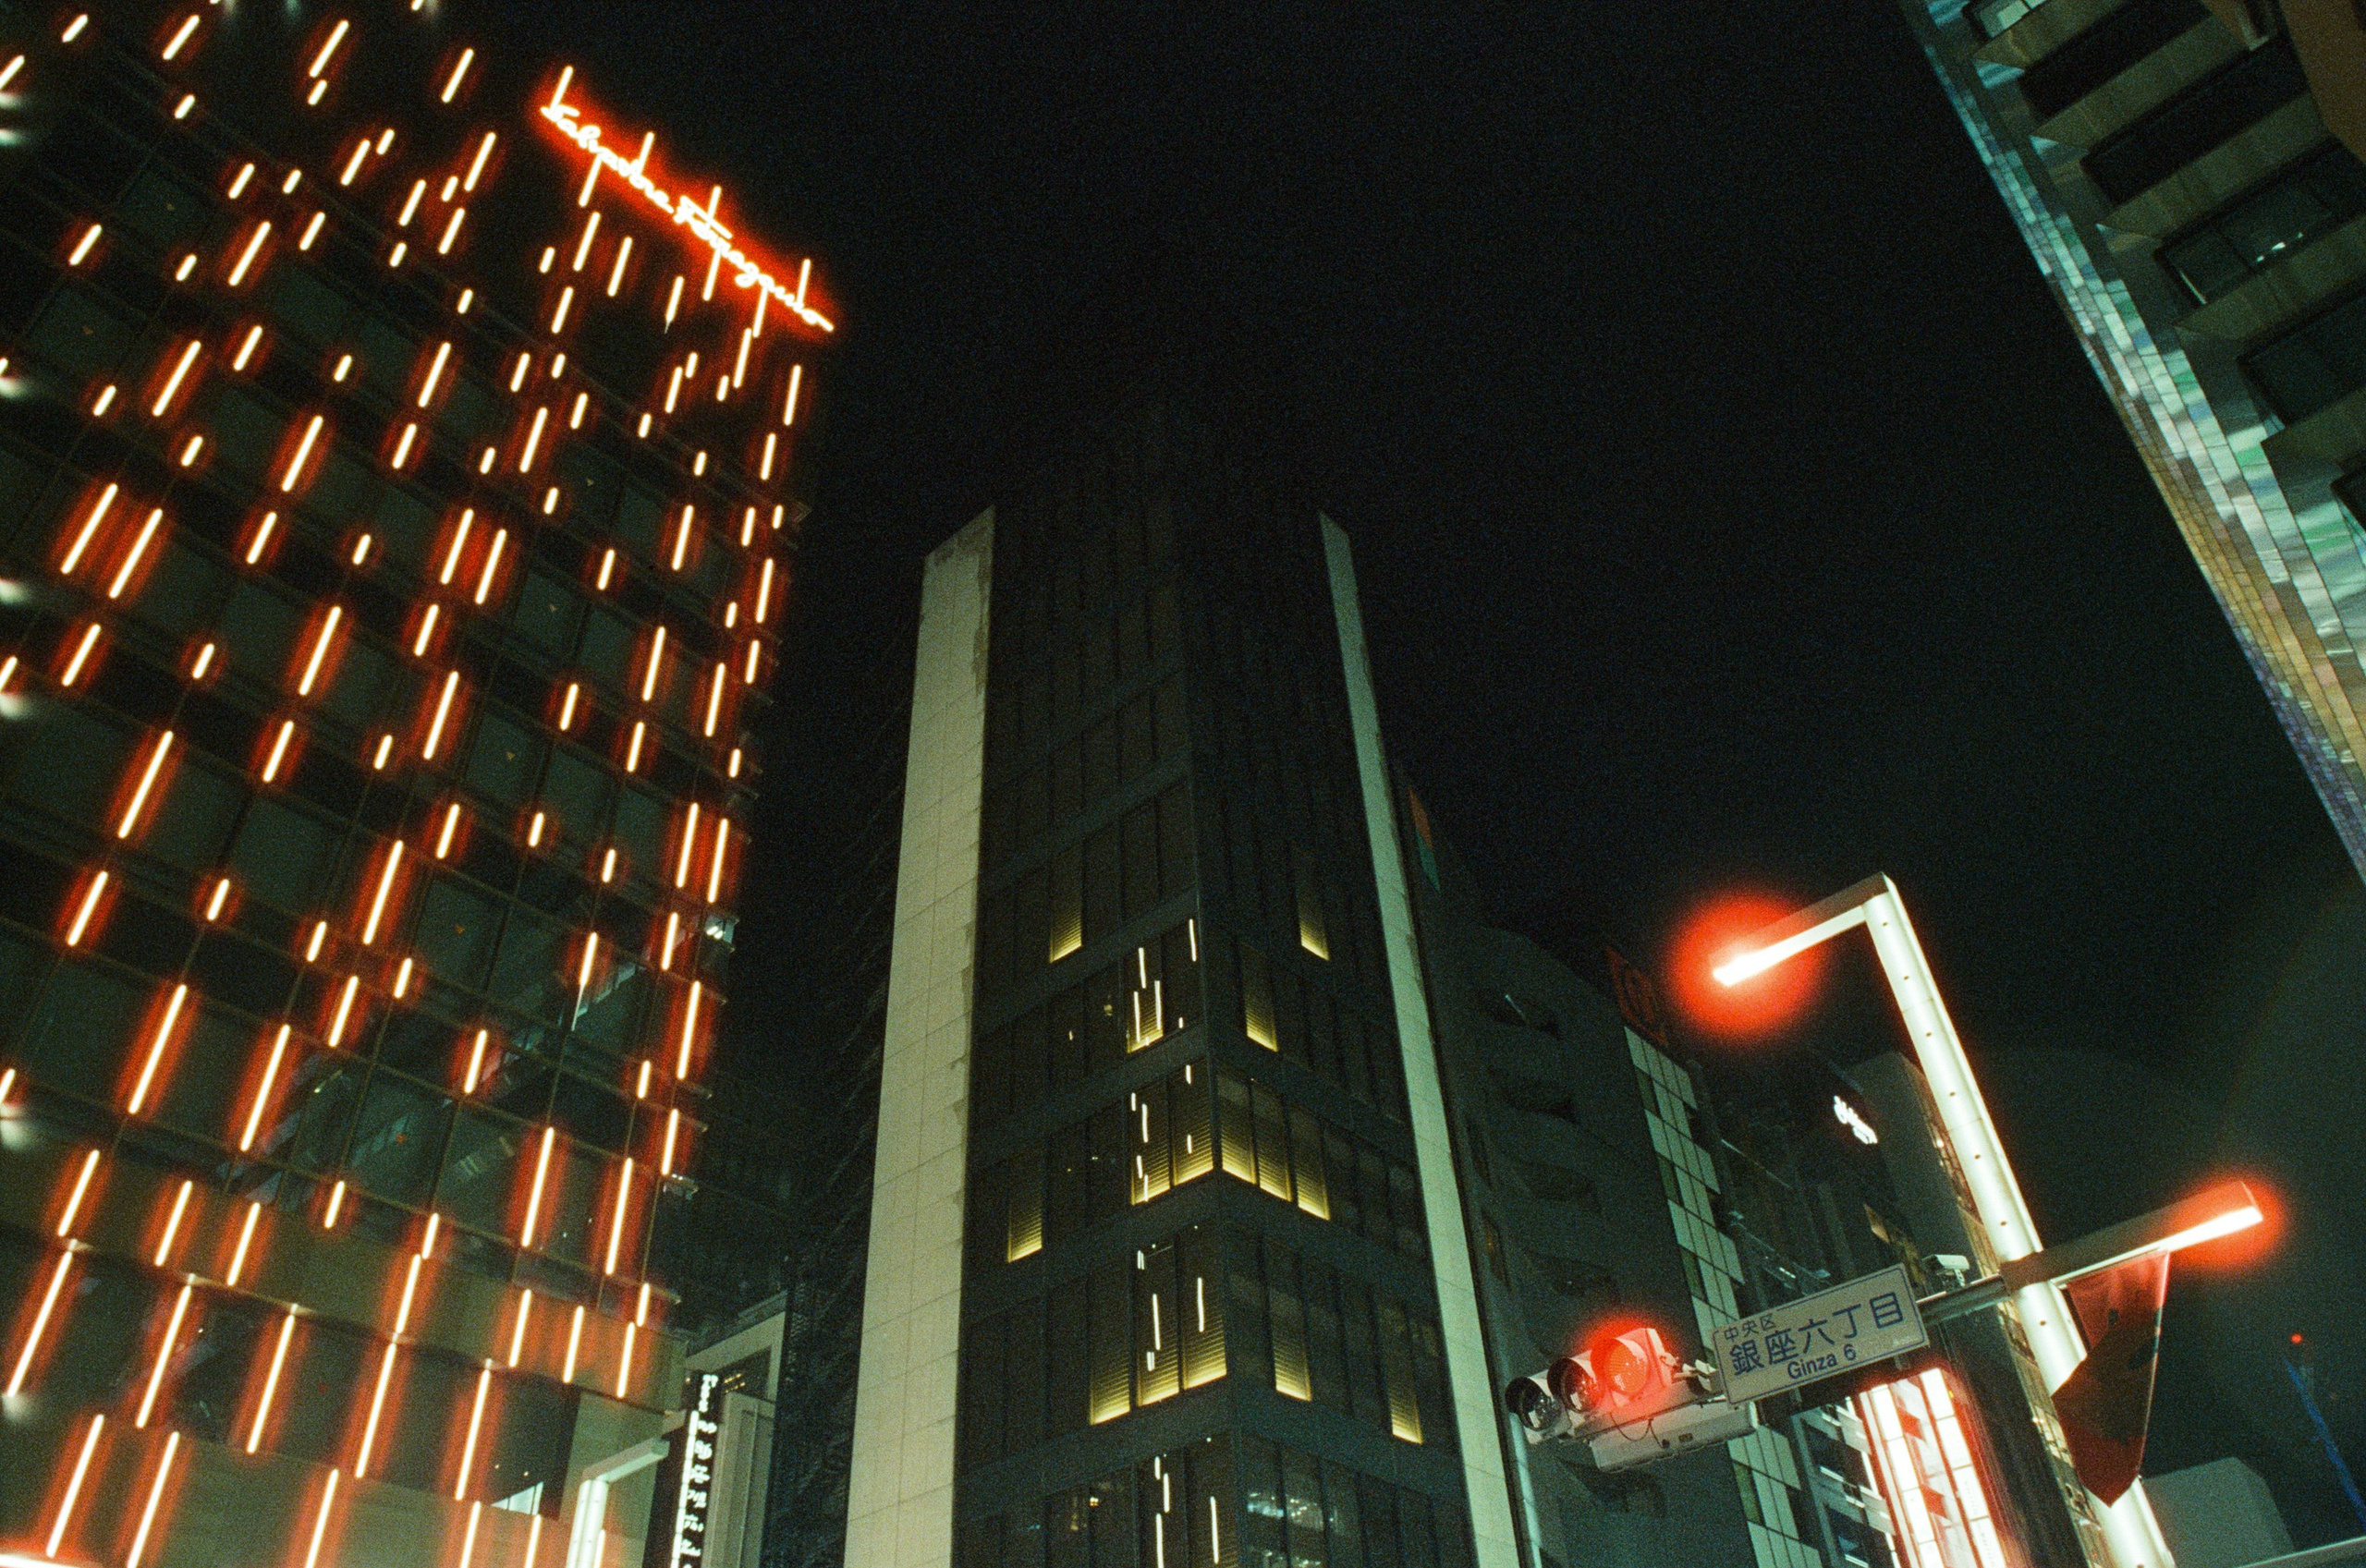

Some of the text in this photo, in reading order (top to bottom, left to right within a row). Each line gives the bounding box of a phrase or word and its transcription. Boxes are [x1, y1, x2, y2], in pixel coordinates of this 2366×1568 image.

[1724, 1312, 1777, 1341] 中央区
[1729, 1292, 1904, 1376] 銀座六丁目
[1787, 1343, 1858, 1380] Ginza 6
